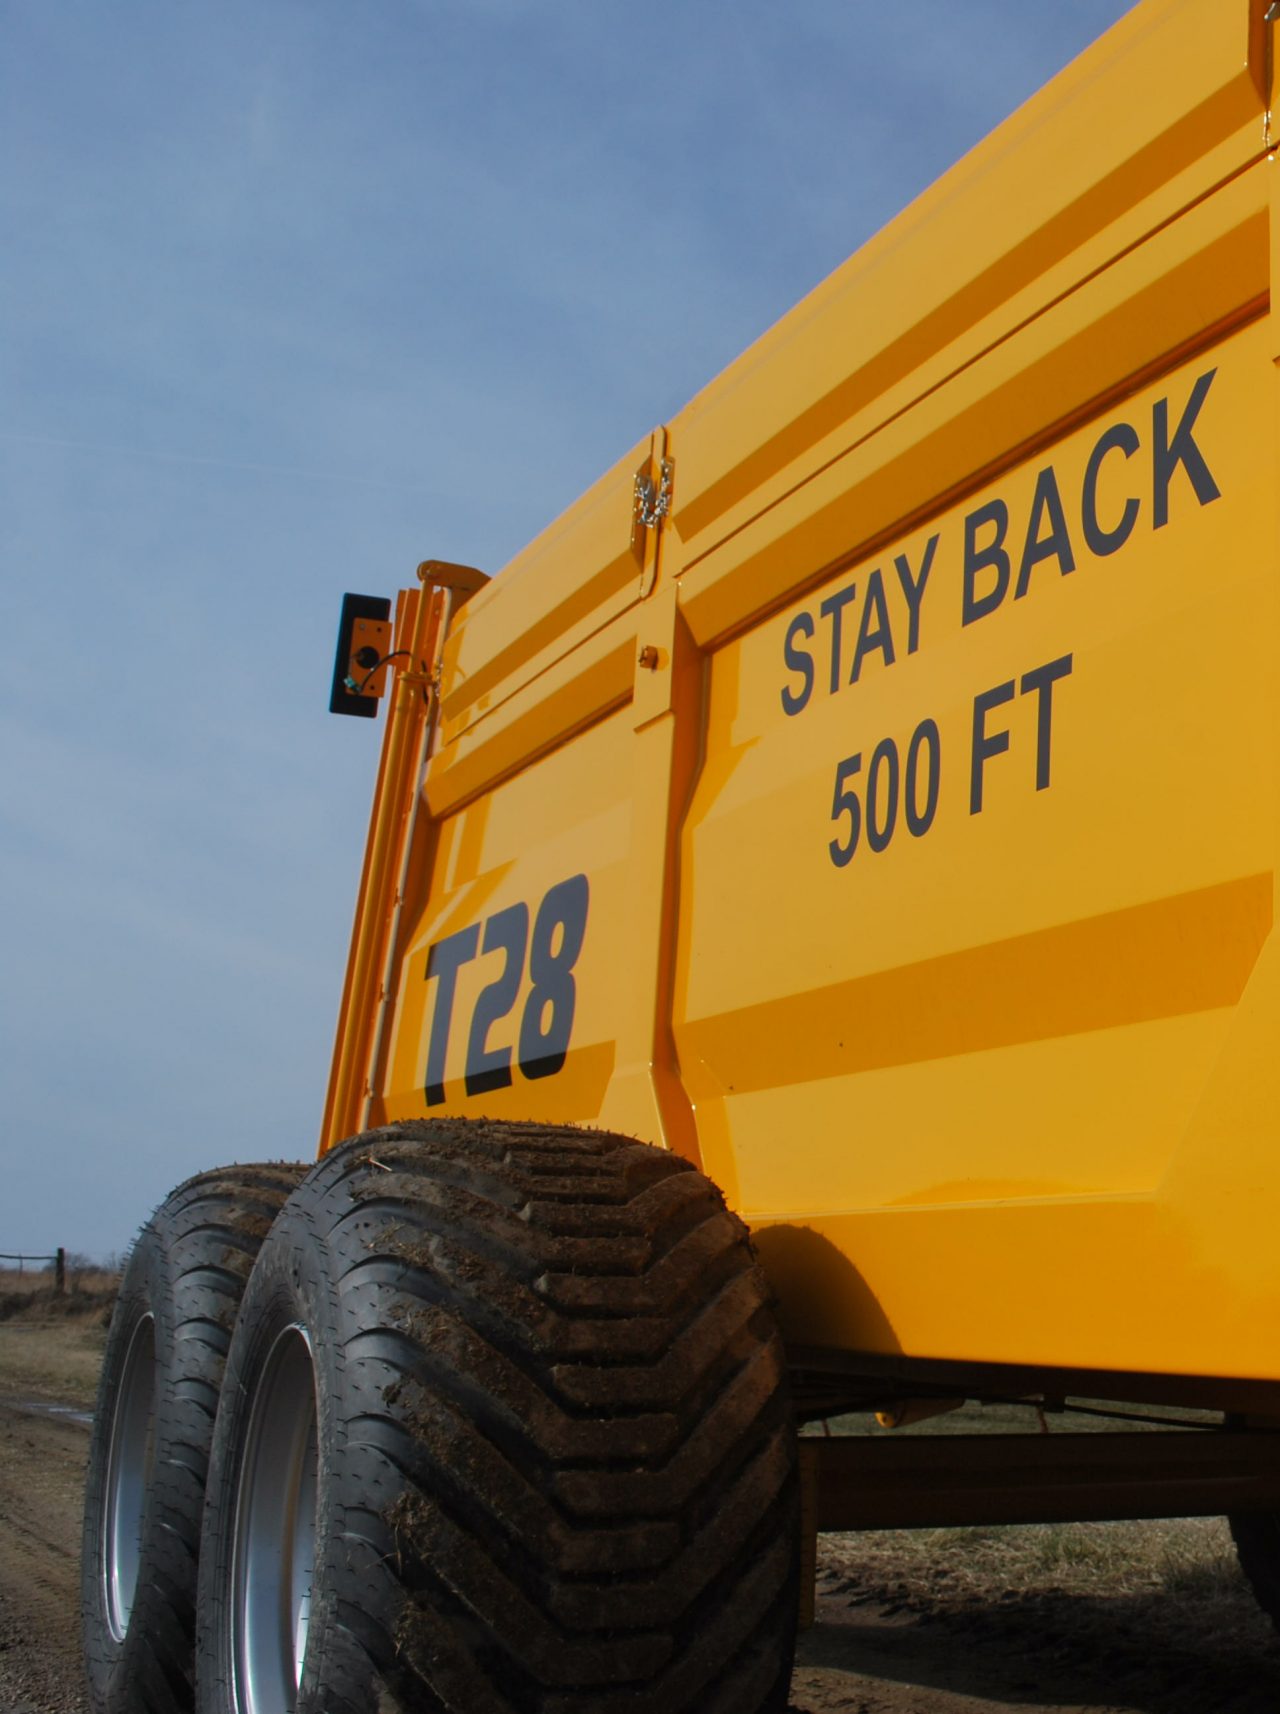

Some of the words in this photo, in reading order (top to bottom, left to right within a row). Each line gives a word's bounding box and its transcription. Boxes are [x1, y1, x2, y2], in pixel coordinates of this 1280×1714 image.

[780, 532, 941, 717] STAY
[962, 366, 1222, 628] BACK
[828, 718, 941, 868] 500
[969, 652, 1074, 816] FT
[424, 872, 590, 1108] T28
